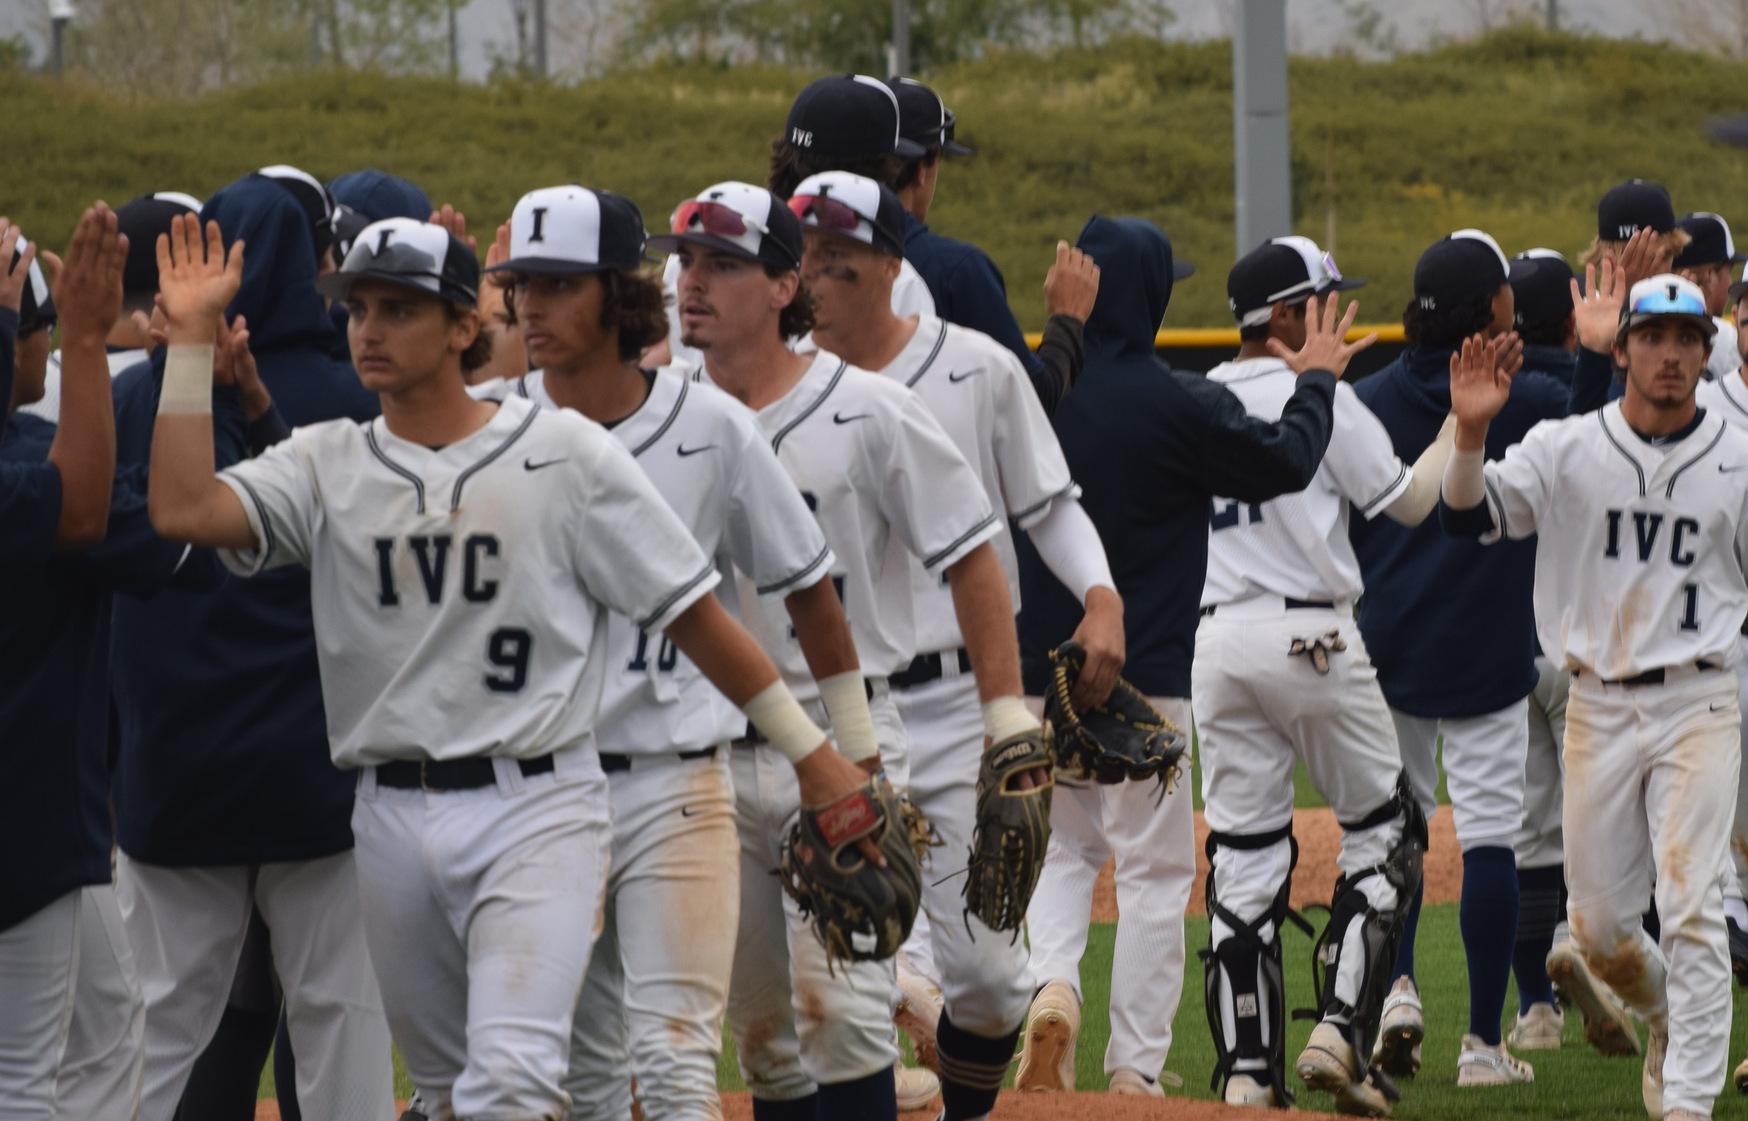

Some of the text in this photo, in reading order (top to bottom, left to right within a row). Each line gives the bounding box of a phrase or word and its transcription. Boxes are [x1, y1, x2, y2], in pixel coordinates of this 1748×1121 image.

[792, 127, 813, 147] IVC
[527, 207, 548, 243] I
[1604, 509, 1700, 567] IVC
[374, 532, 500, 607] IVC
[1679, 582, 1700, 631] 1
[484, 626, 534, 694] 9
